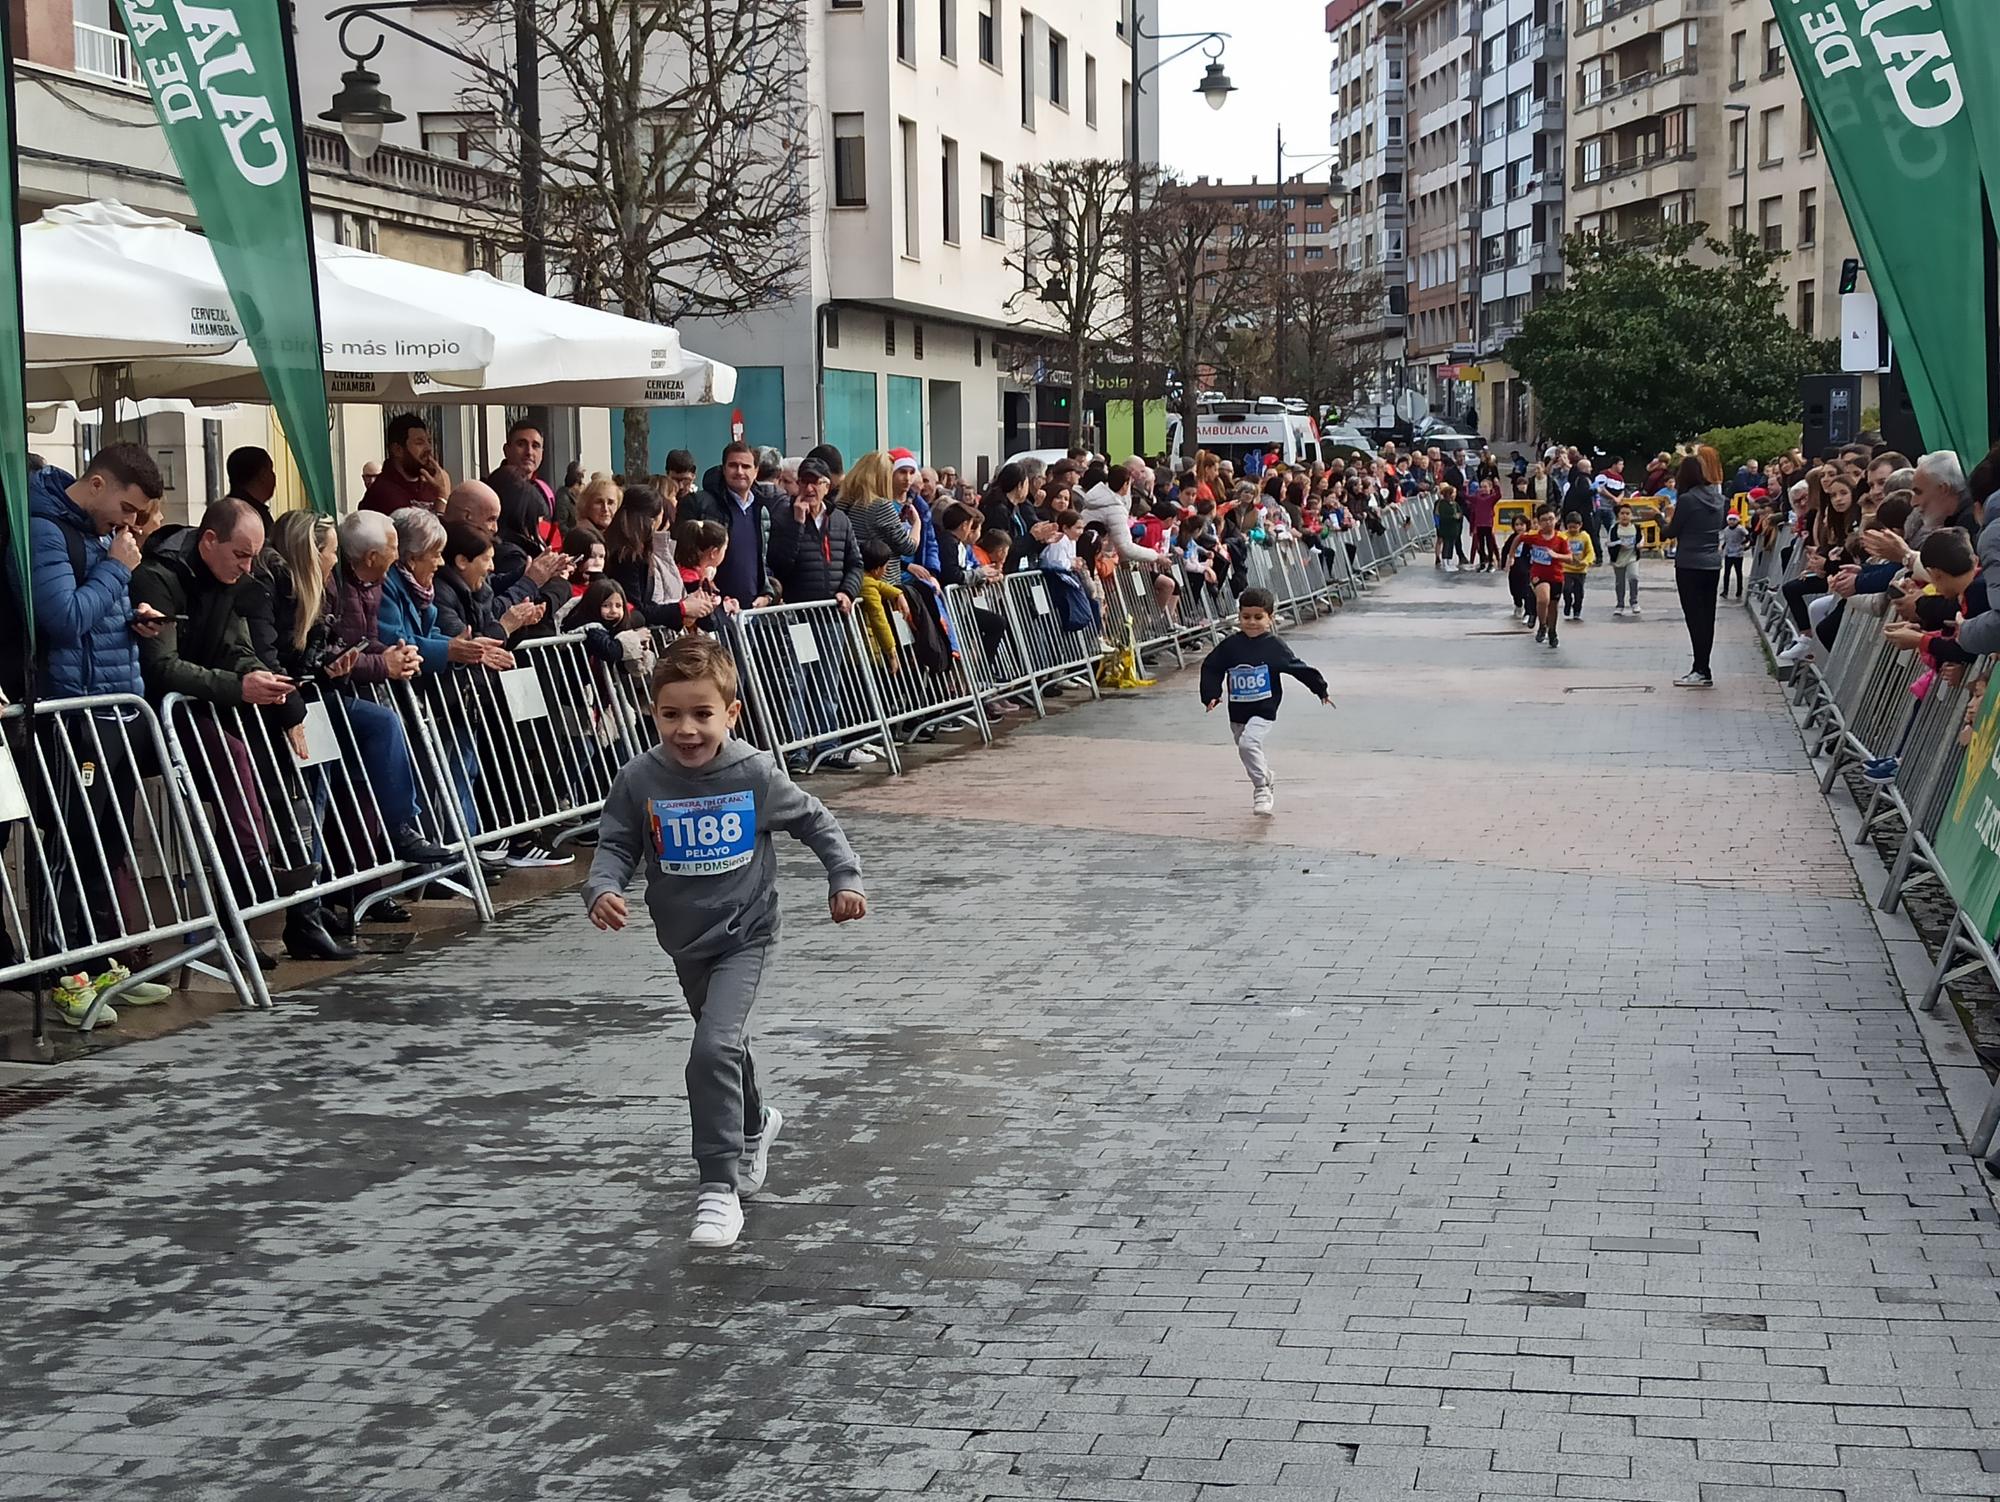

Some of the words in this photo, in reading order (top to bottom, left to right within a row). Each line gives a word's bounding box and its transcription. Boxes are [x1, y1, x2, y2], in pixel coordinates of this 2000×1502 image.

[191, 307, 231, 322] CERVEZAS
[190, 323, 239, 337] ALHAMBRA
[341, 339, 388, 356] más
[395, 338, 461, 359] limpio
[331, 380, 376, 393] ALHAMBRA
[646, 379, 685, 390] CERVEZAS
[644, 390, 686, 400] ALHAMBRA
[1231, 672, 1266, 690] 1086
[667, 812, 743, 848] 1188
[685, 846, 730, 858] PELAYO
